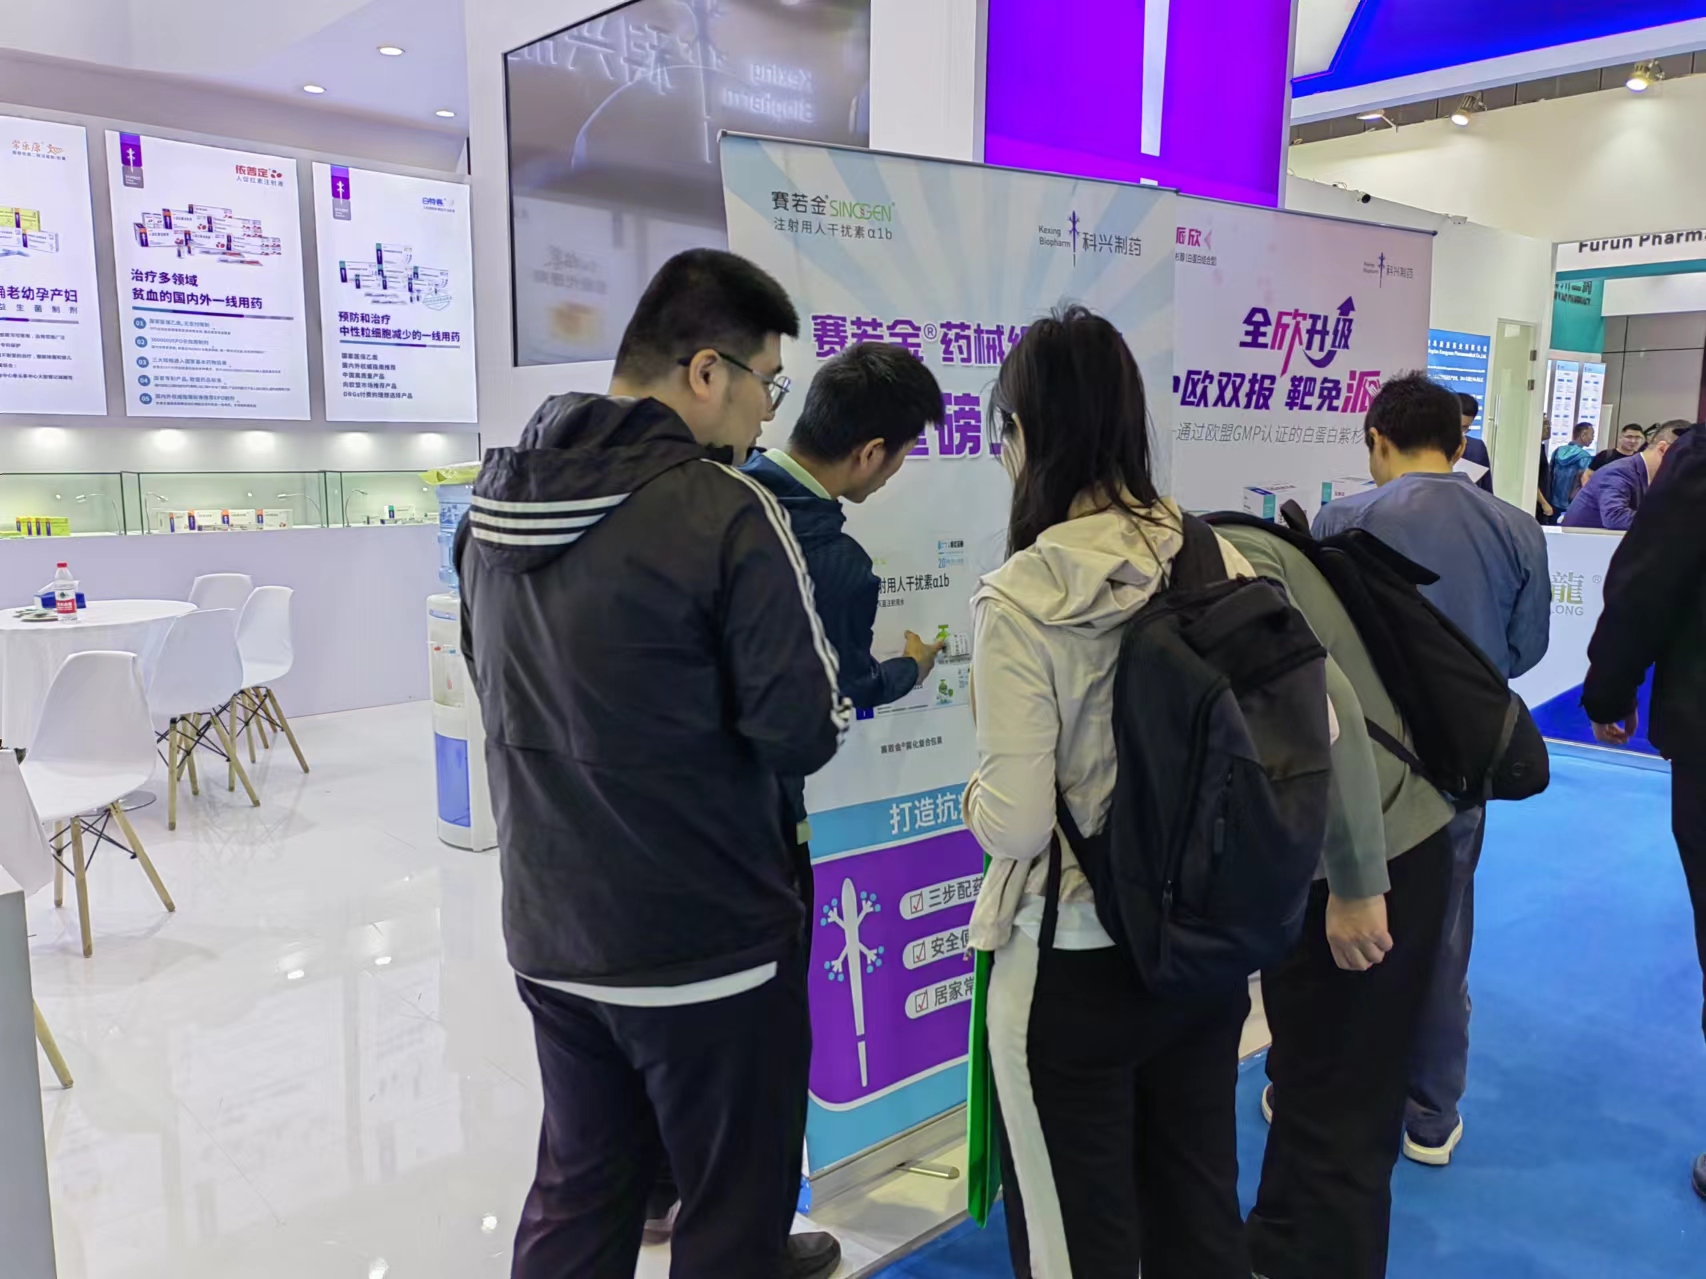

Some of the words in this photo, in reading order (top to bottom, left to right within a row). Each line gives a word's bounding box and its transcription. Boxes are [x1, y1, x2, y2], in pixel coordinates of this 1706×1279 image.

[1038, 225, 1061, 237] Kexing
[1039, 236, 1071, 248] Biopharm
[1082, 231, 1142, 257] 科兴制药
[1579, 237, 1633, 253] Furun
[131, 268, 199, 287] 治疗多领域
[132, 288, 263, 310] 贫血的国内外一线用药
[338, 311, 391, 325] 预防和治疗
[340, 326, 460, 342] 中性粒细胞减少的一线用药
[1239, 306, 1354, 377] 全欣升级
[1552, 605, 1584, 616] ONG
[890, 788, 965, 836] 打造抗
